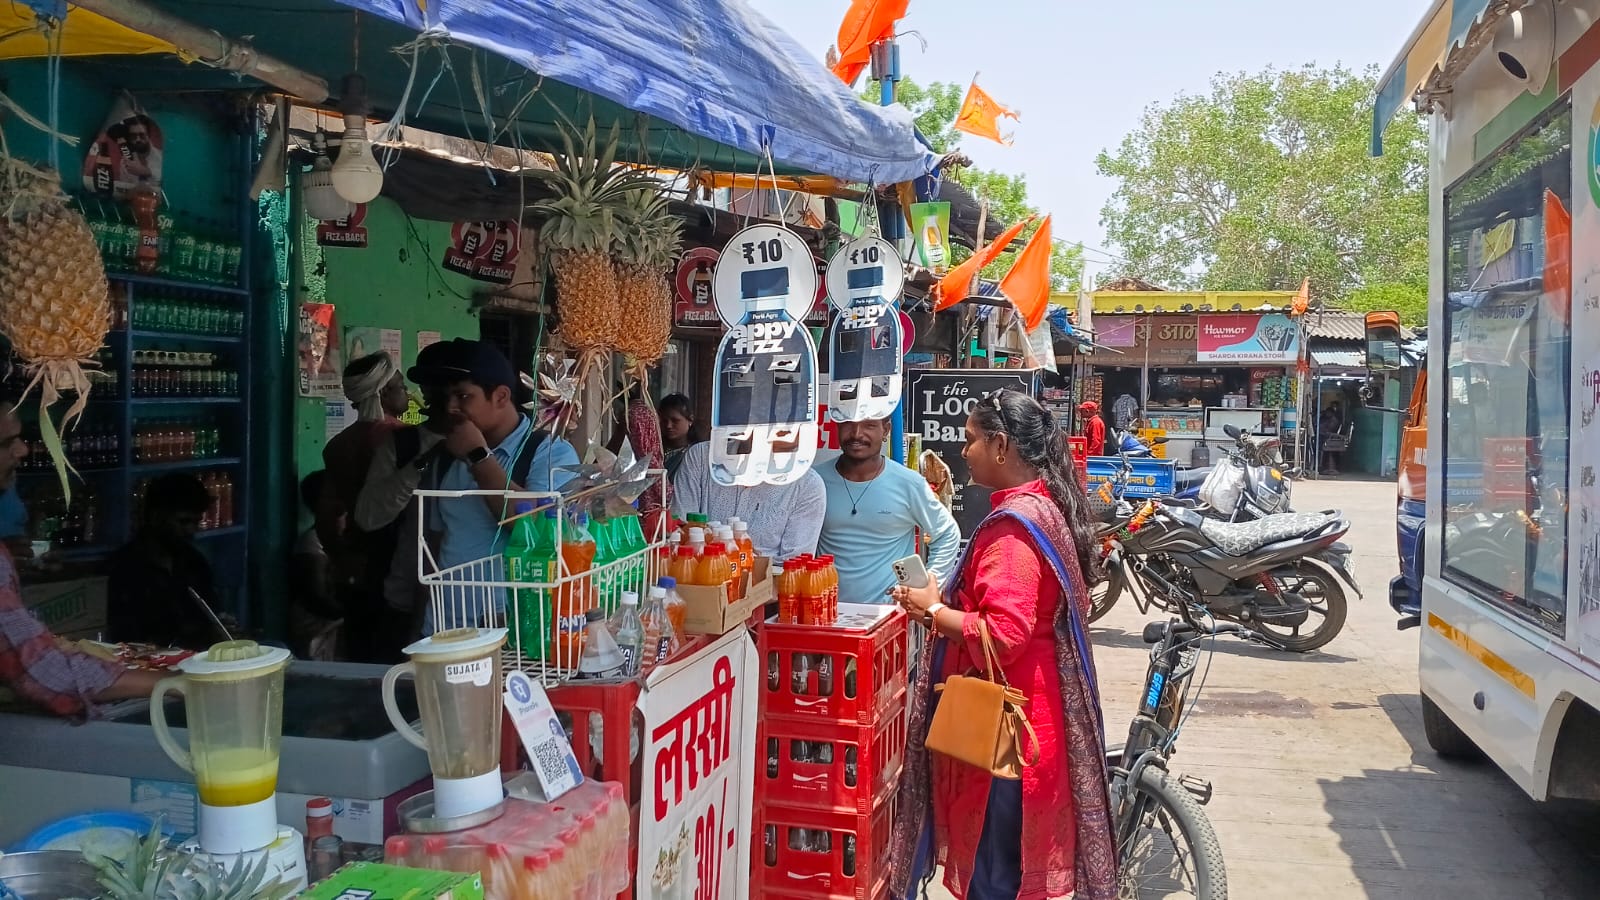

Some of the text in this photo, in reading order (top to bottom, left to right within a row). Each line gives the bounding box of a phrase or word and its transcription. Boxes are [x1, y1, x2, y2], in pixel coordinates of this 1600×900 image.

[97, 167, 110, 190] FIZZ
[345, 232, 366, 242] BACK
[464, 235, 478, 255] FIZZ
[492, 243, 505, 262] FIZZ
[741, 238, 783, 265] ₹10
[695, 284, 709, 304] FIZZ
[841, 303, 887, 320] appy
[732, 320, 798, 342] appy
[842, 317, 879, 330] fizz
[1203, 324, 1247, 335] Havmor
[732, 337, 784, 355] fizz
[943, 381, 969, 396] the
[447, 662, 481, 676] SUJATA
[652, 655, 736, 822] लस्सी
